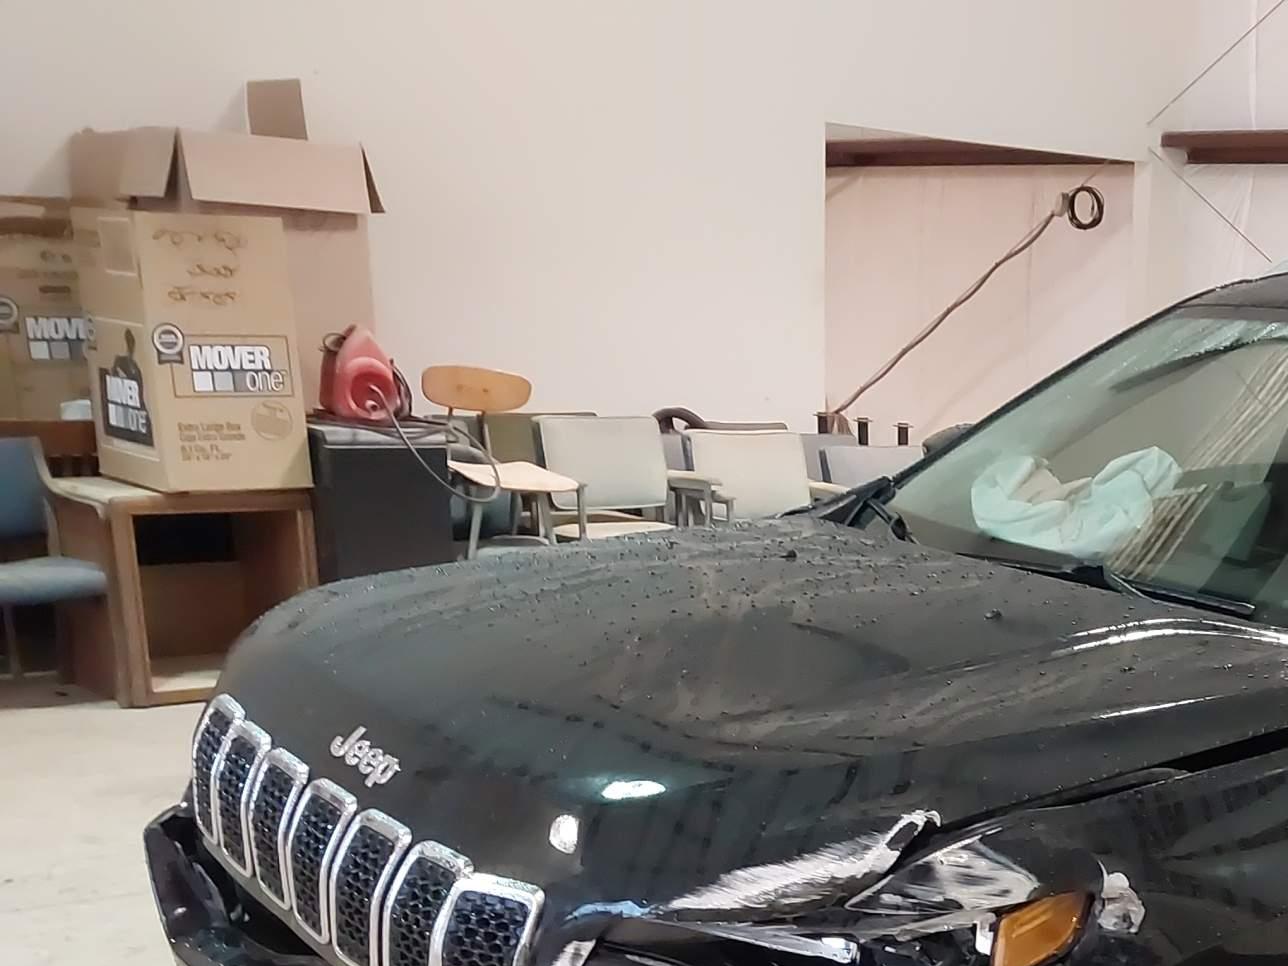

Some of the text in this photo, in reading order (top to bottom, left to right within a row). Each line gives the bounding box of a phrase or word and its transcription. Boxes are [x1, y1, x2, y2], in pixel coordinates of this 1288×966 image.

[189, 344, 272, 370] MOVER
[246, 371, 285, 392] one
[330, 726, 401, 788] Jeep
